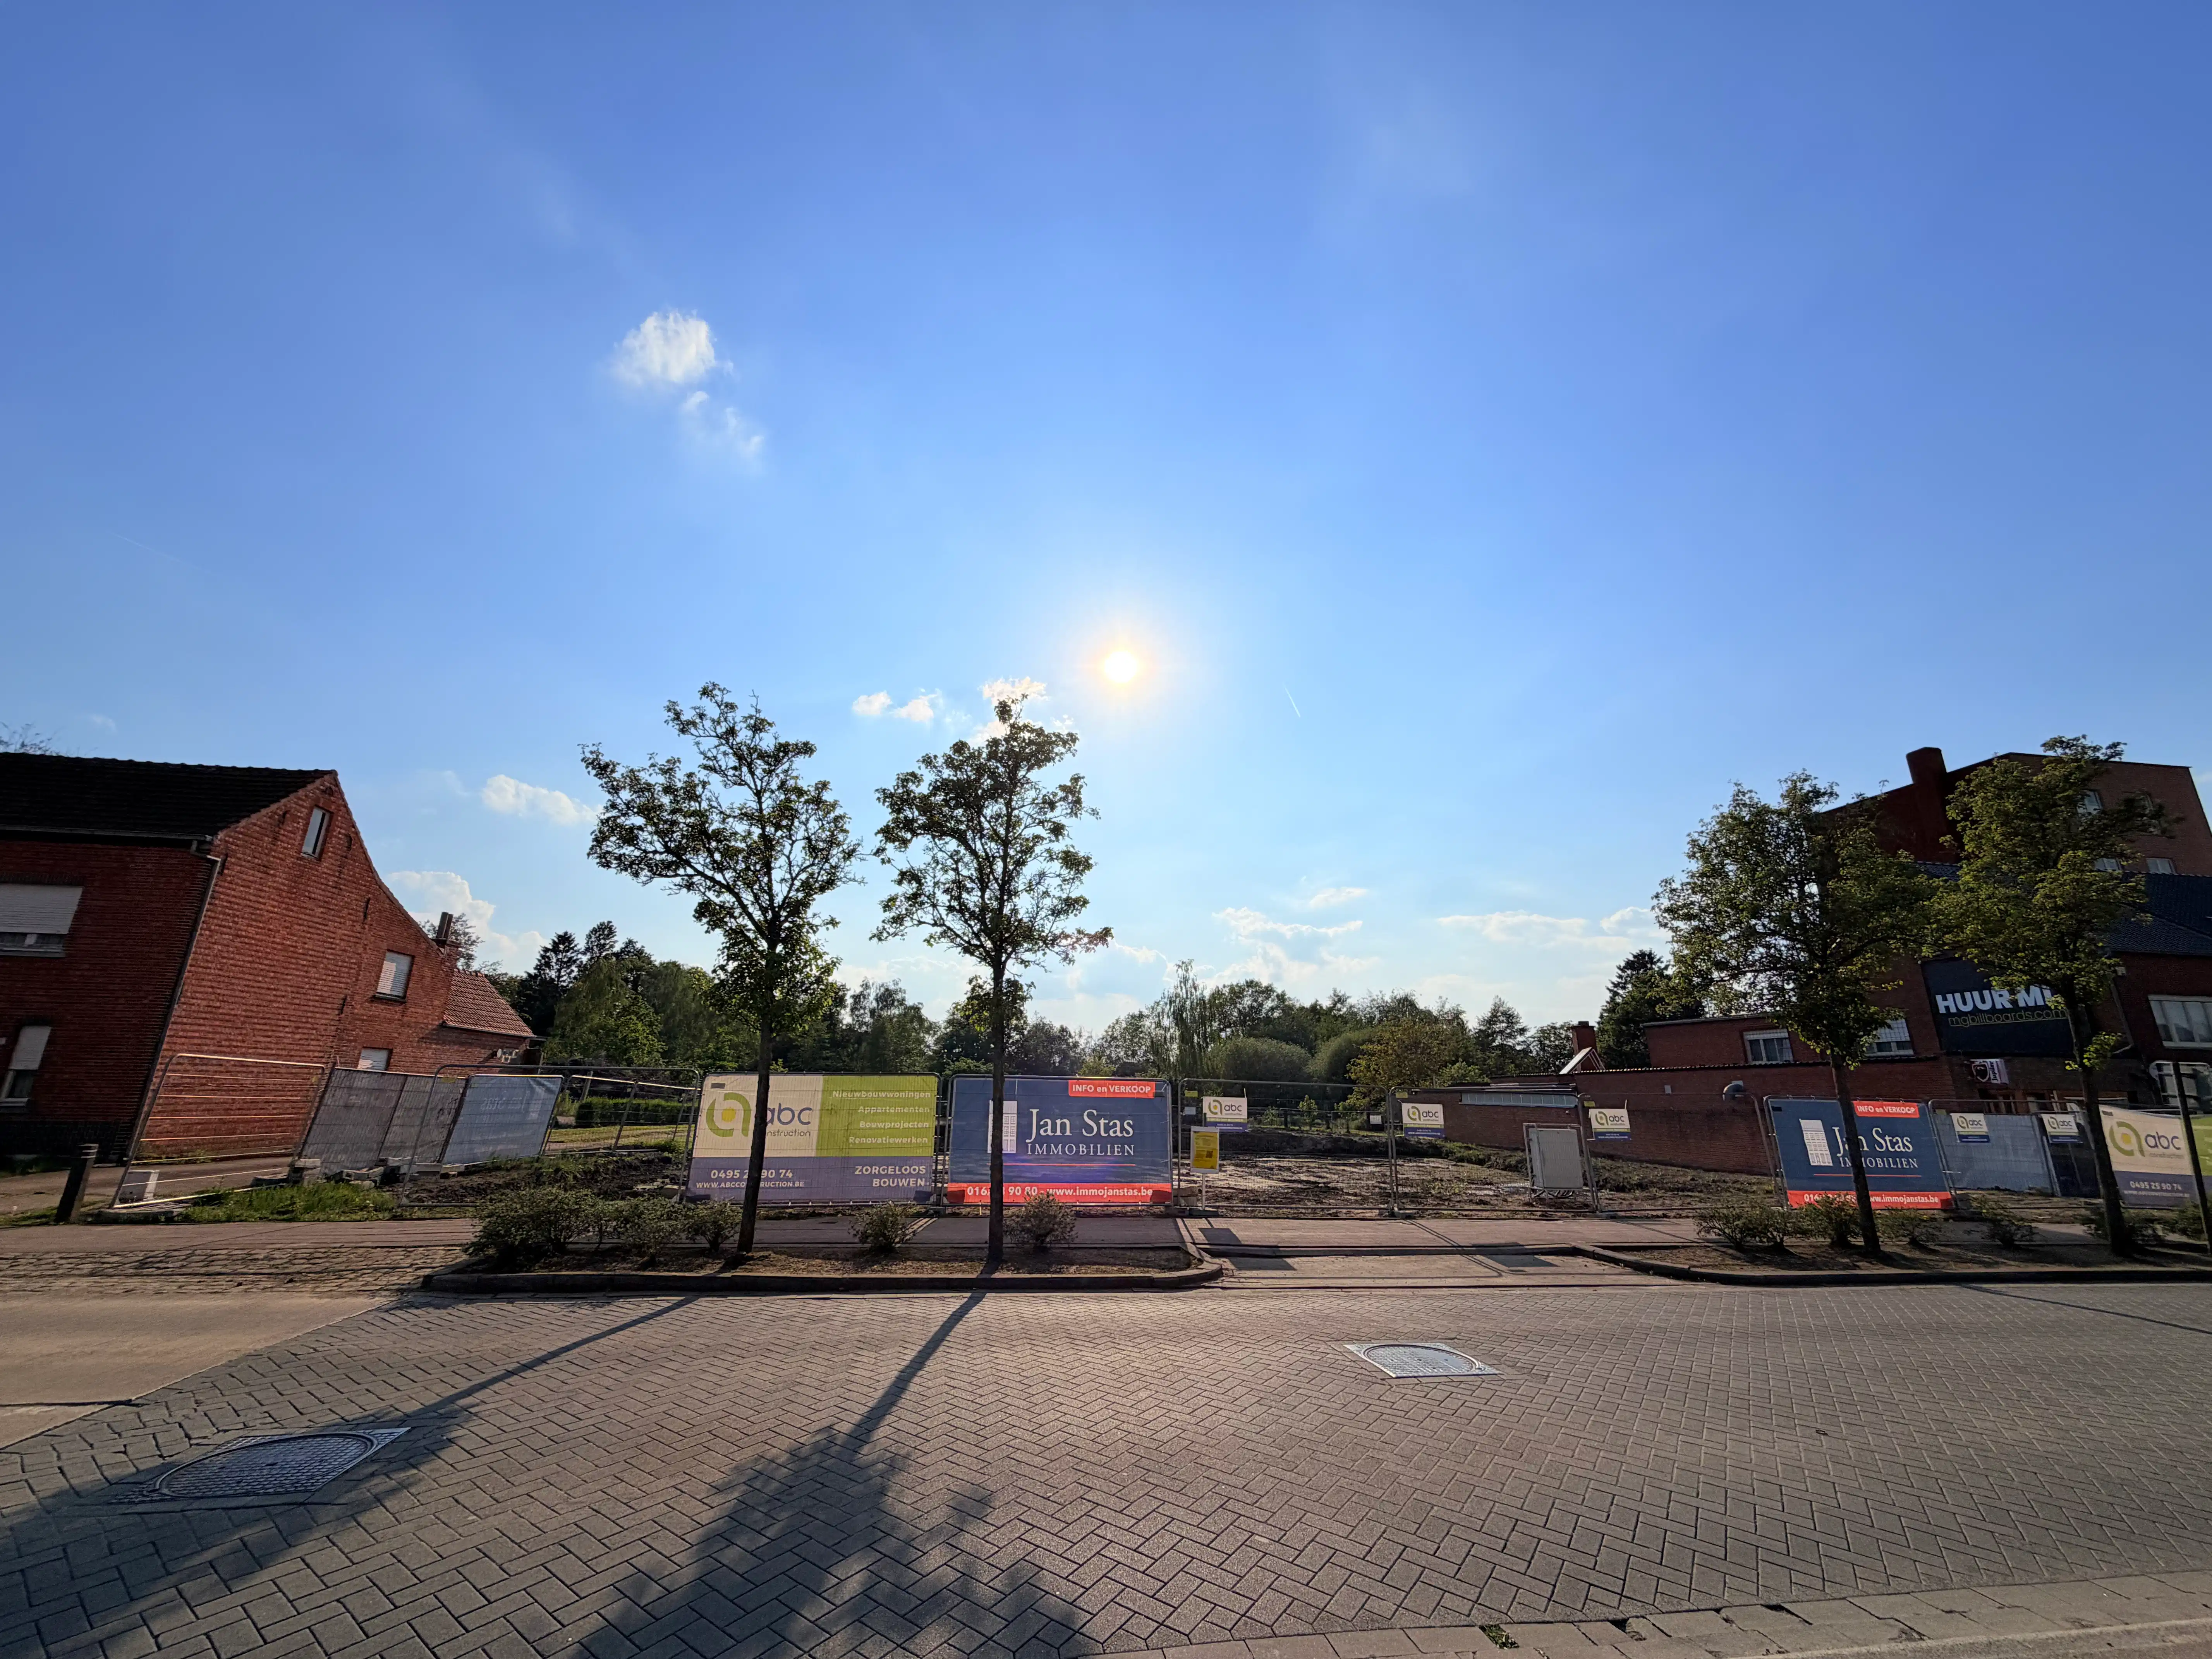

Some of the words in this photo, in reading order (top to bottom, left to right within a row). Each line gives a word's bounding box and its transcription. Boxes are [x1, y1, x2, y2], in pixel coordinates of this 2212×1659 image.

[1935, 989, 2013, 1014] HUUR
[1948, 1008, 2068, 1027] mgbillboards.com
[1072, 1084, 1094, 1092] INFO
[1109, 1085, 1151, 1093] VERKOOP
[832, 1091, 931, 1099] Nieuwbouwwoningen
[858, 1106, 930, 1114] Appartementen
[1224, 1103, 1242, 1112] abc
[1883, 1106, 1916, 1114] VERKOOP
[1422, 1109, 1439, 1118] abc
[859, 1121, 929, 1129] Bouwprojecten
[1025, 1109, 1072, 1143] Jan
[1082, 1109, 1134, 1137] Stas
[1968, 1118, 1983, 1126] abc
[766, 1128, 811, 1137] nstruction
[1872, 1127, 1913, 1152] Stas
[2145, 1131, 2181, 1151] abc
[1027, 1143, 1135, 1156] IMMOBILIEN
[1839, 1157, 1919, 1168] IOBILIEN
[710, 1170, 740, 1179] 0495
[779, 1169, 793, 1178] 74
[854, 1166, 926, 1175] ZORGELOOS
[872, 1178, 925, 1187] BOUWEN
[1008, 1186, 1022, 1196] 90
[1046, 1186, 1153, 1198] www.immojanstas.be
